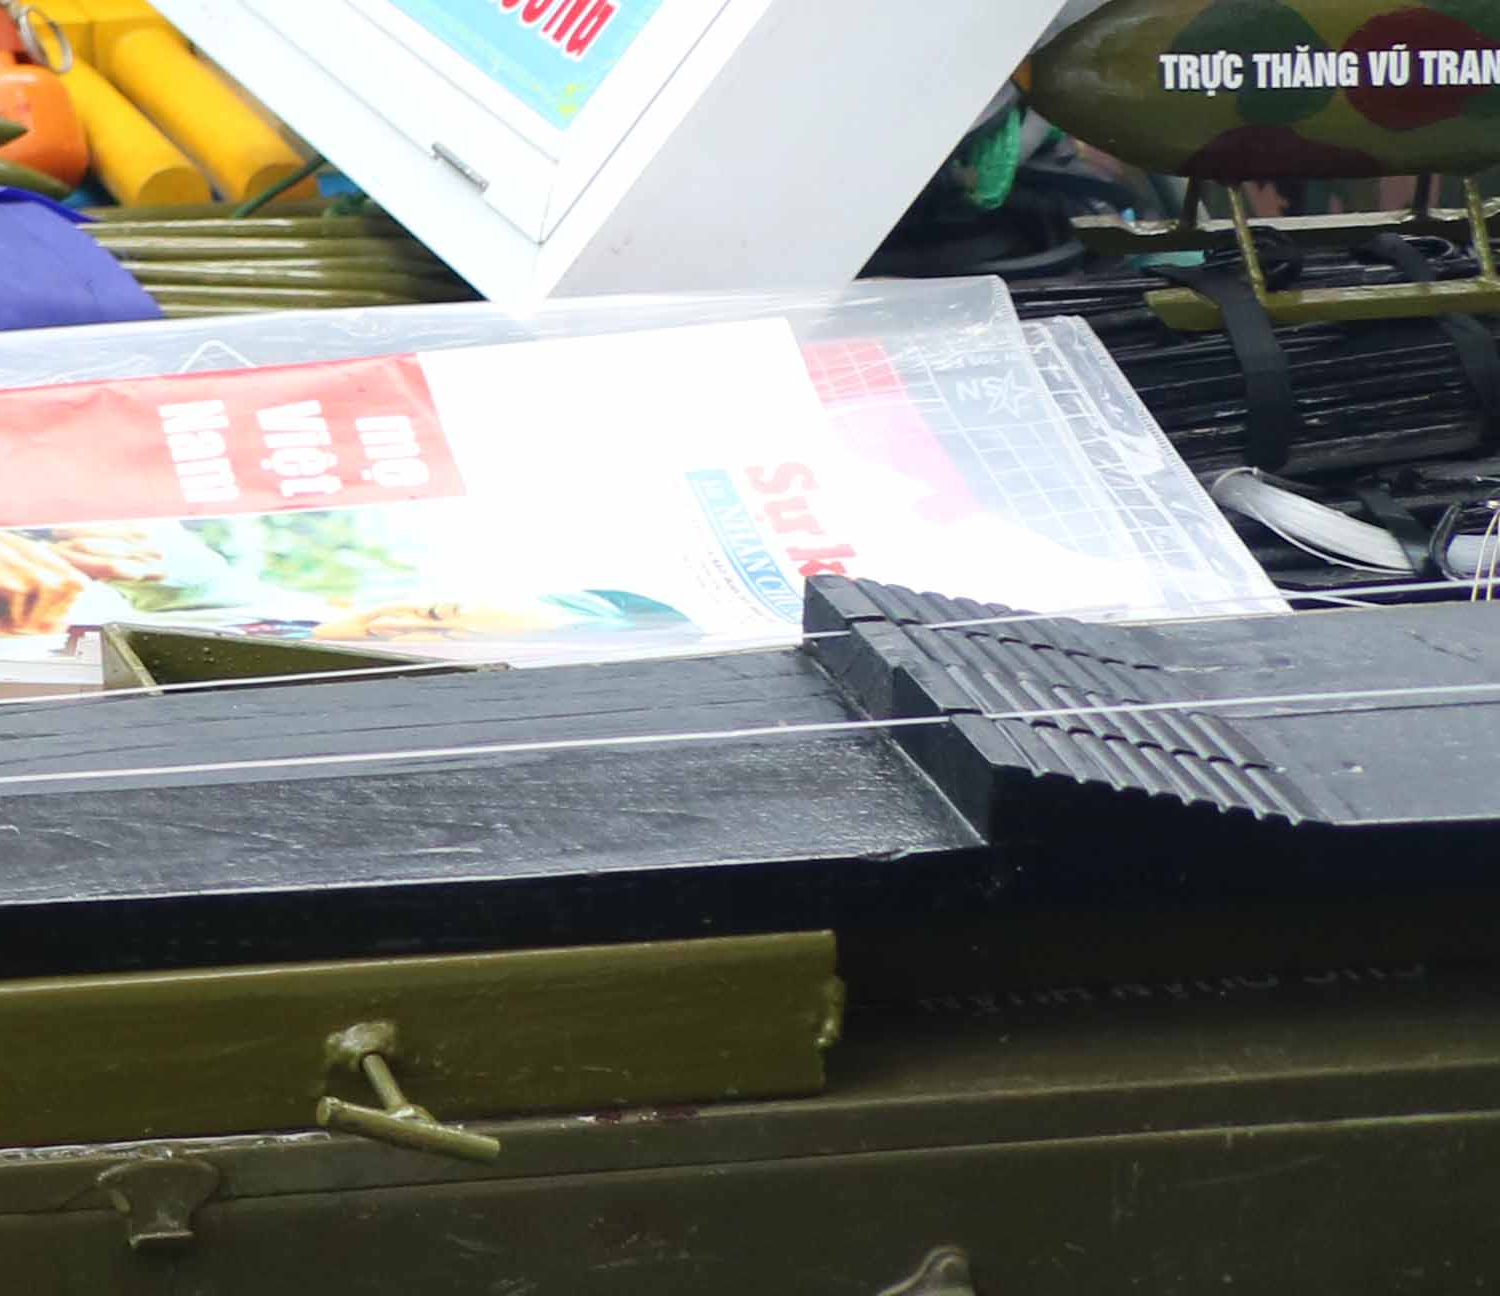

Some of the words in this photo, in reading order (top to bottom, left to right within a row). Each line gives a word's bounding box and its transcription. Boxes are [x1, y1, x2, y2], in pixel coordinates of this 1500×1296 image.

[1159, 49, 1244, 97] TRỰC
[1252, 44, 1359, 89] THĂNG
[1367, 43, 1410, 87] VŨ
[1418, 49, 1500, 87] TRAN
[157, 399, 241, 503] Nam
[255, 399, 342, 497] Việt
[355, 414, 430, 488] mẹ
